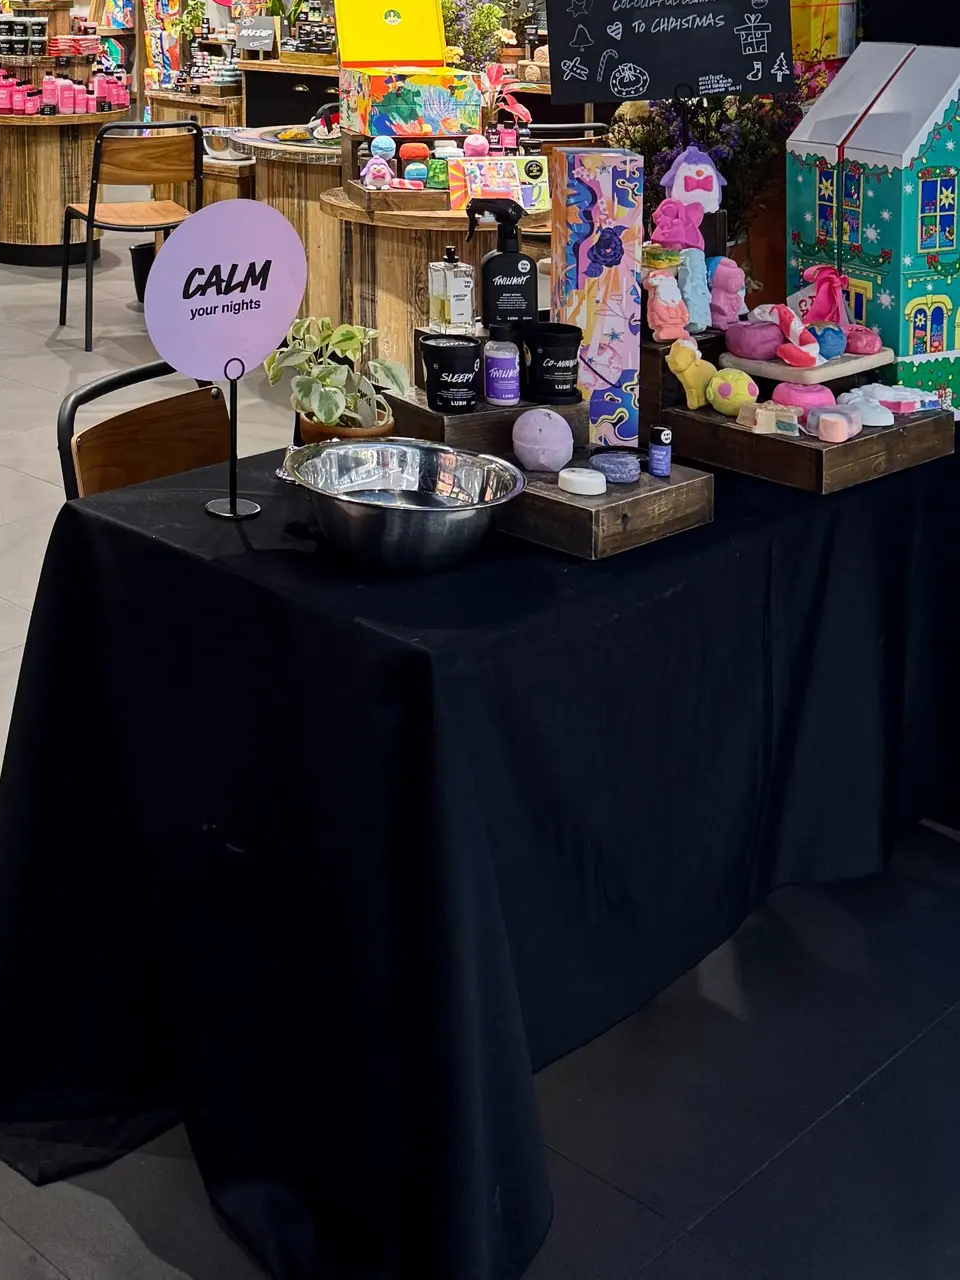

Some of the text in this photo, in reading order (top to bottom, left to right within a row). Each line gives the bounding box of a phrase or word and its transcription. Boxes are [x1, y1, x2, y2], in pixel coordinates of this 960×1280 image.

[632, 13, 726, 34] TO CHRISTMAS
[239, 28, 274, 37] MAKEUP
[182, 259, 272, 300] CALM
[492, 275, 530, 286] TWILIGHT
[190, 298, 261, 321] your nights
[440, 371, 476, 383] SLEEPY
